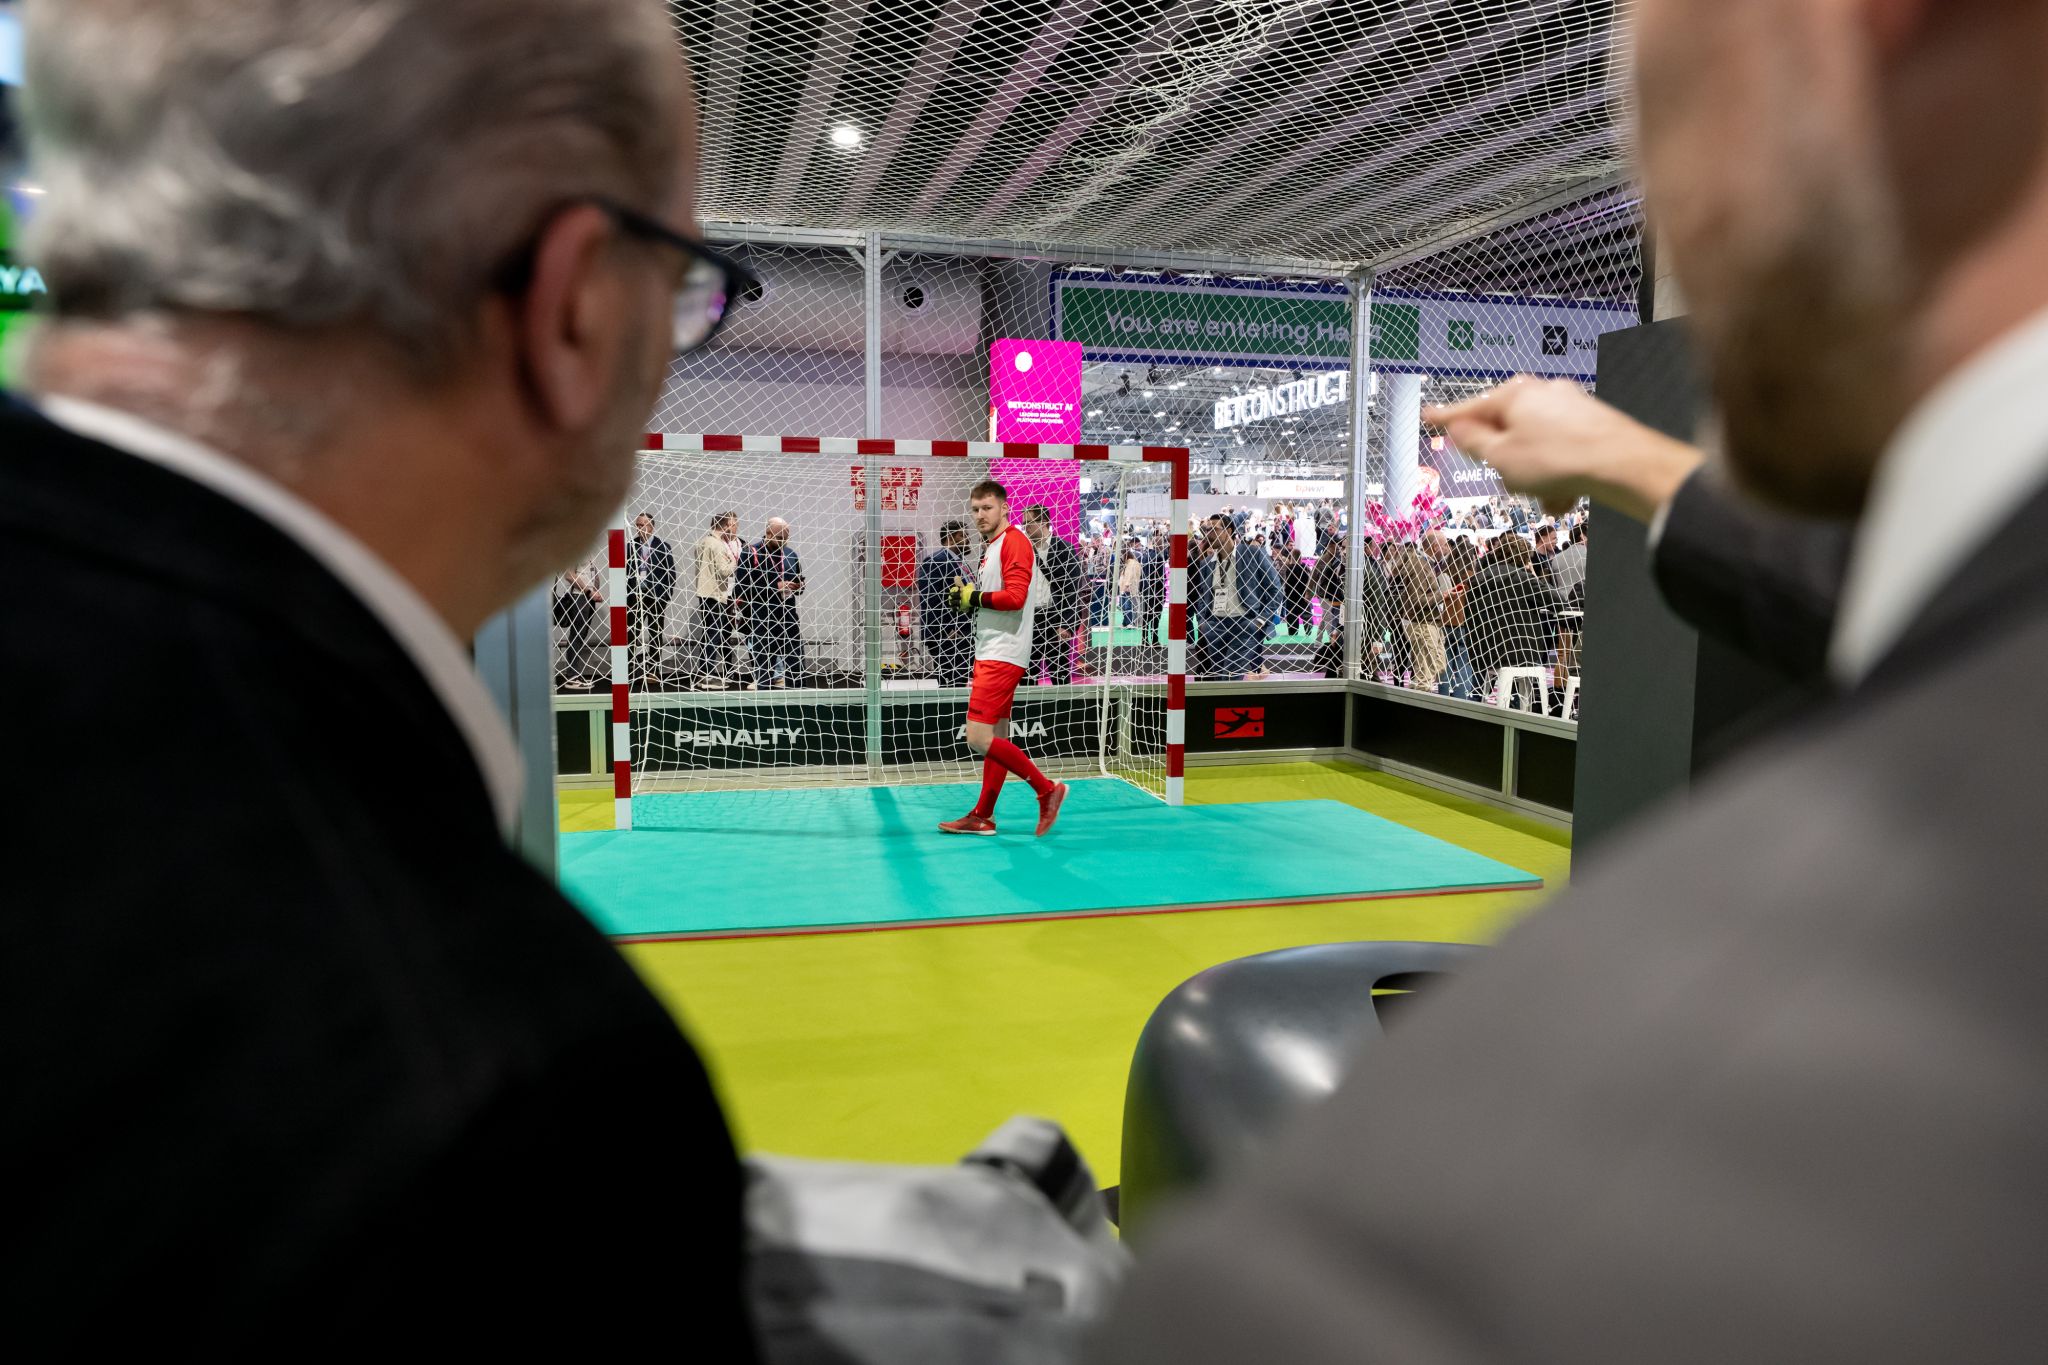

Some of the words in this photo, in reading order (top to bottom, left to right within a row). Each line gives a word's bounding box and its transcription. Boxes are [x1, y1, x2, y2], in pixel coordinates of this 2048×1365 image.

[1105, 309, 1153, 333] You
[1159, 317, 1199, 336] are
[1204, 317, 1310, 346] entering
[1315, 320, 1352, 343] Ha
[1480, 333, 1504, 346] Hall
[1506, 335, 1515, 347] 5
[1007, 401, 1064, 411] BETCONSTRUCT
[1214, 370, 1349, 430] BETCONSTRUCT
[1453, 467, 1483, 484] GAME
[674, 727, 803, 748] PENALTY
[955, 721, 1048, 740] ANA
